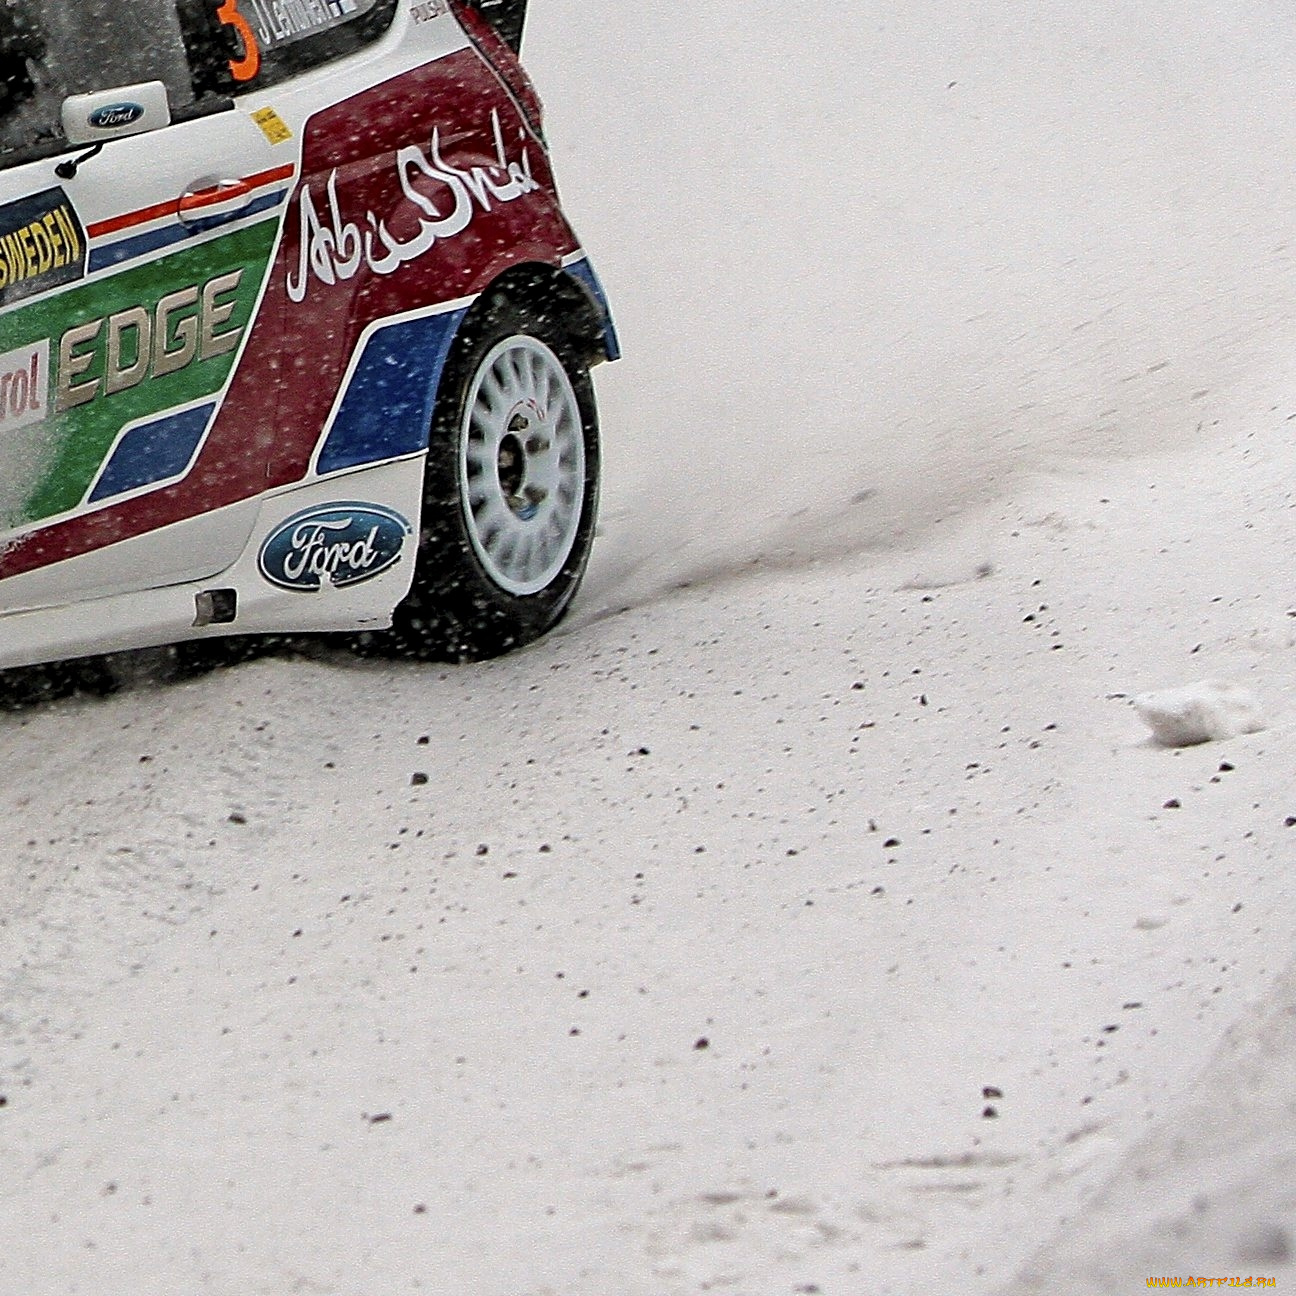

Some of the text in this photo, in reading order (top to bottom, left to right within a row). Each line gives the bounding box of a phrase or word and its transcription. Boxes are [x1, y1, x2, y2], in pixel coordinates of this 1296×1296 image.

[99, 106, 134, 125] Ford
[53, 267, 248, 413] EDGE
[284, 517, 379, 579] Ford
